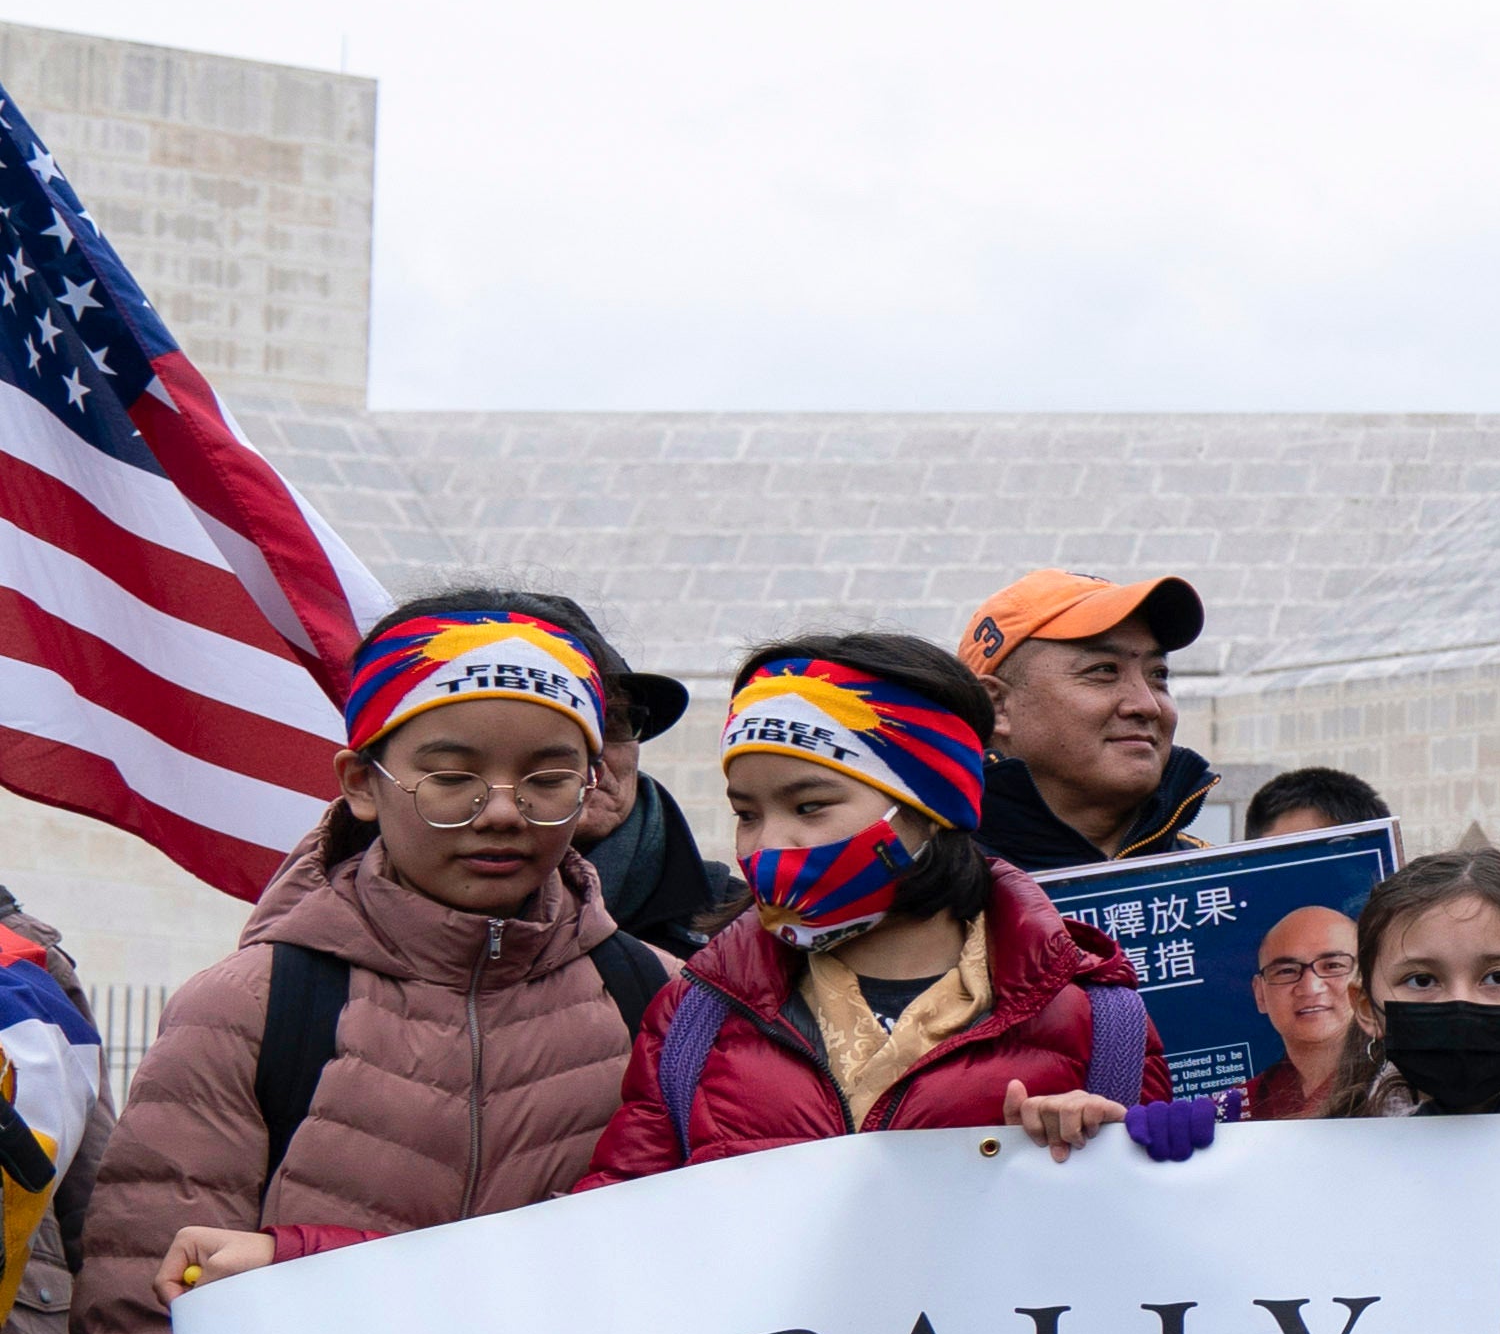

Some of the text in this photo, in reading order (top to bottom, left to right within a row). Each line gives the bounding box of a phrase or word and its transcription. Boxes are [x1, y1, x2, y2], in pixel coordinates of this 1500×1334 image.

[466, 664, 570, 691] FREE
[436, 675, 587, 711] TIBET
[742, 716, 835, 744] FREE
[727, 729, 861, 763] TIBET
[1168, 1055, 1212, 1070] onsidered
